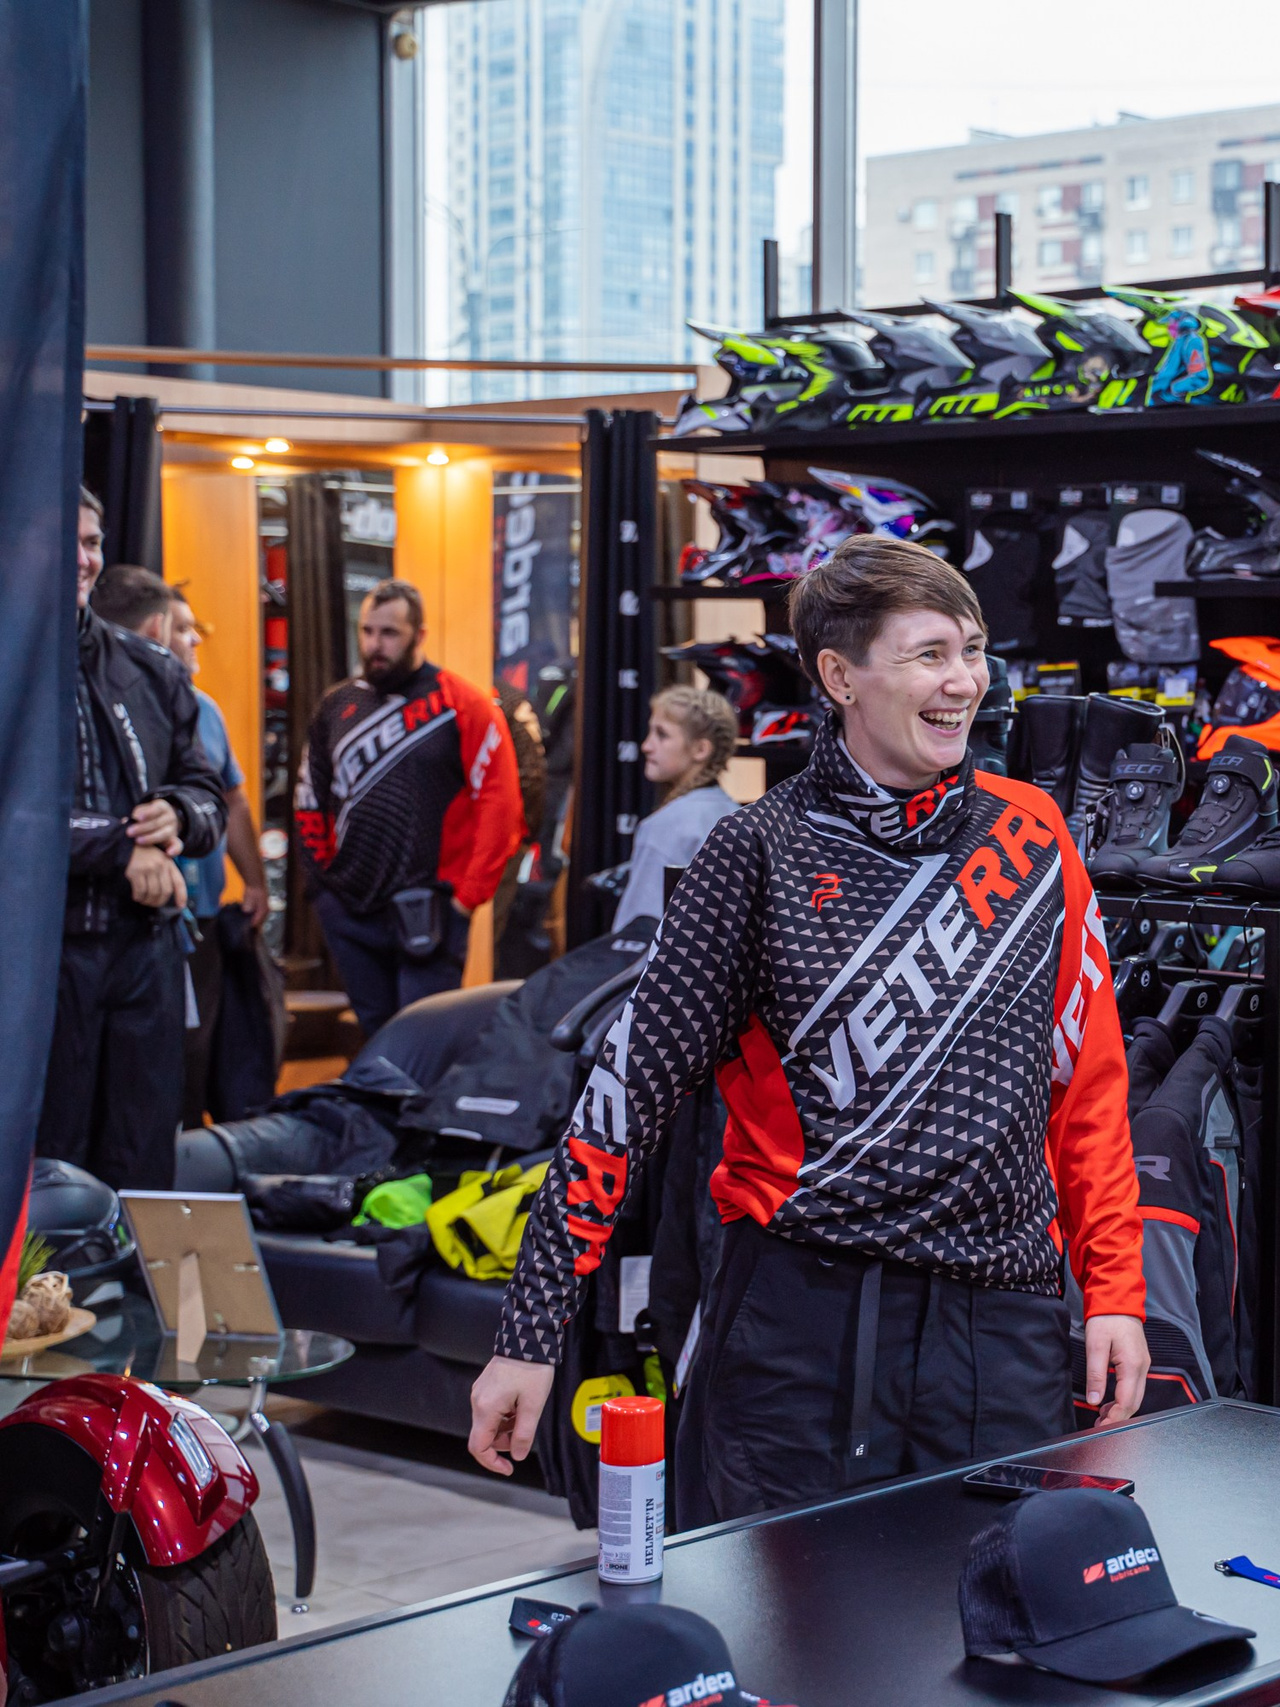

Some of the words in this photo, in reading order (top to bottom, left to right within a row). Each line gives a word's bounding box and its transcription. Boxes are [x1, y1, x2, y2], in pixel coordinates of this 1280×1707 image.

[1210, 755, 1244, 767] ECA
[808, 802, 1056, 1112] VETERR
[645, 1498, 655, 1567] HELMET'IN
[1106, 1547, 1160, 1575] ardeca
[667, 1671, 736, 1707] ardeca
